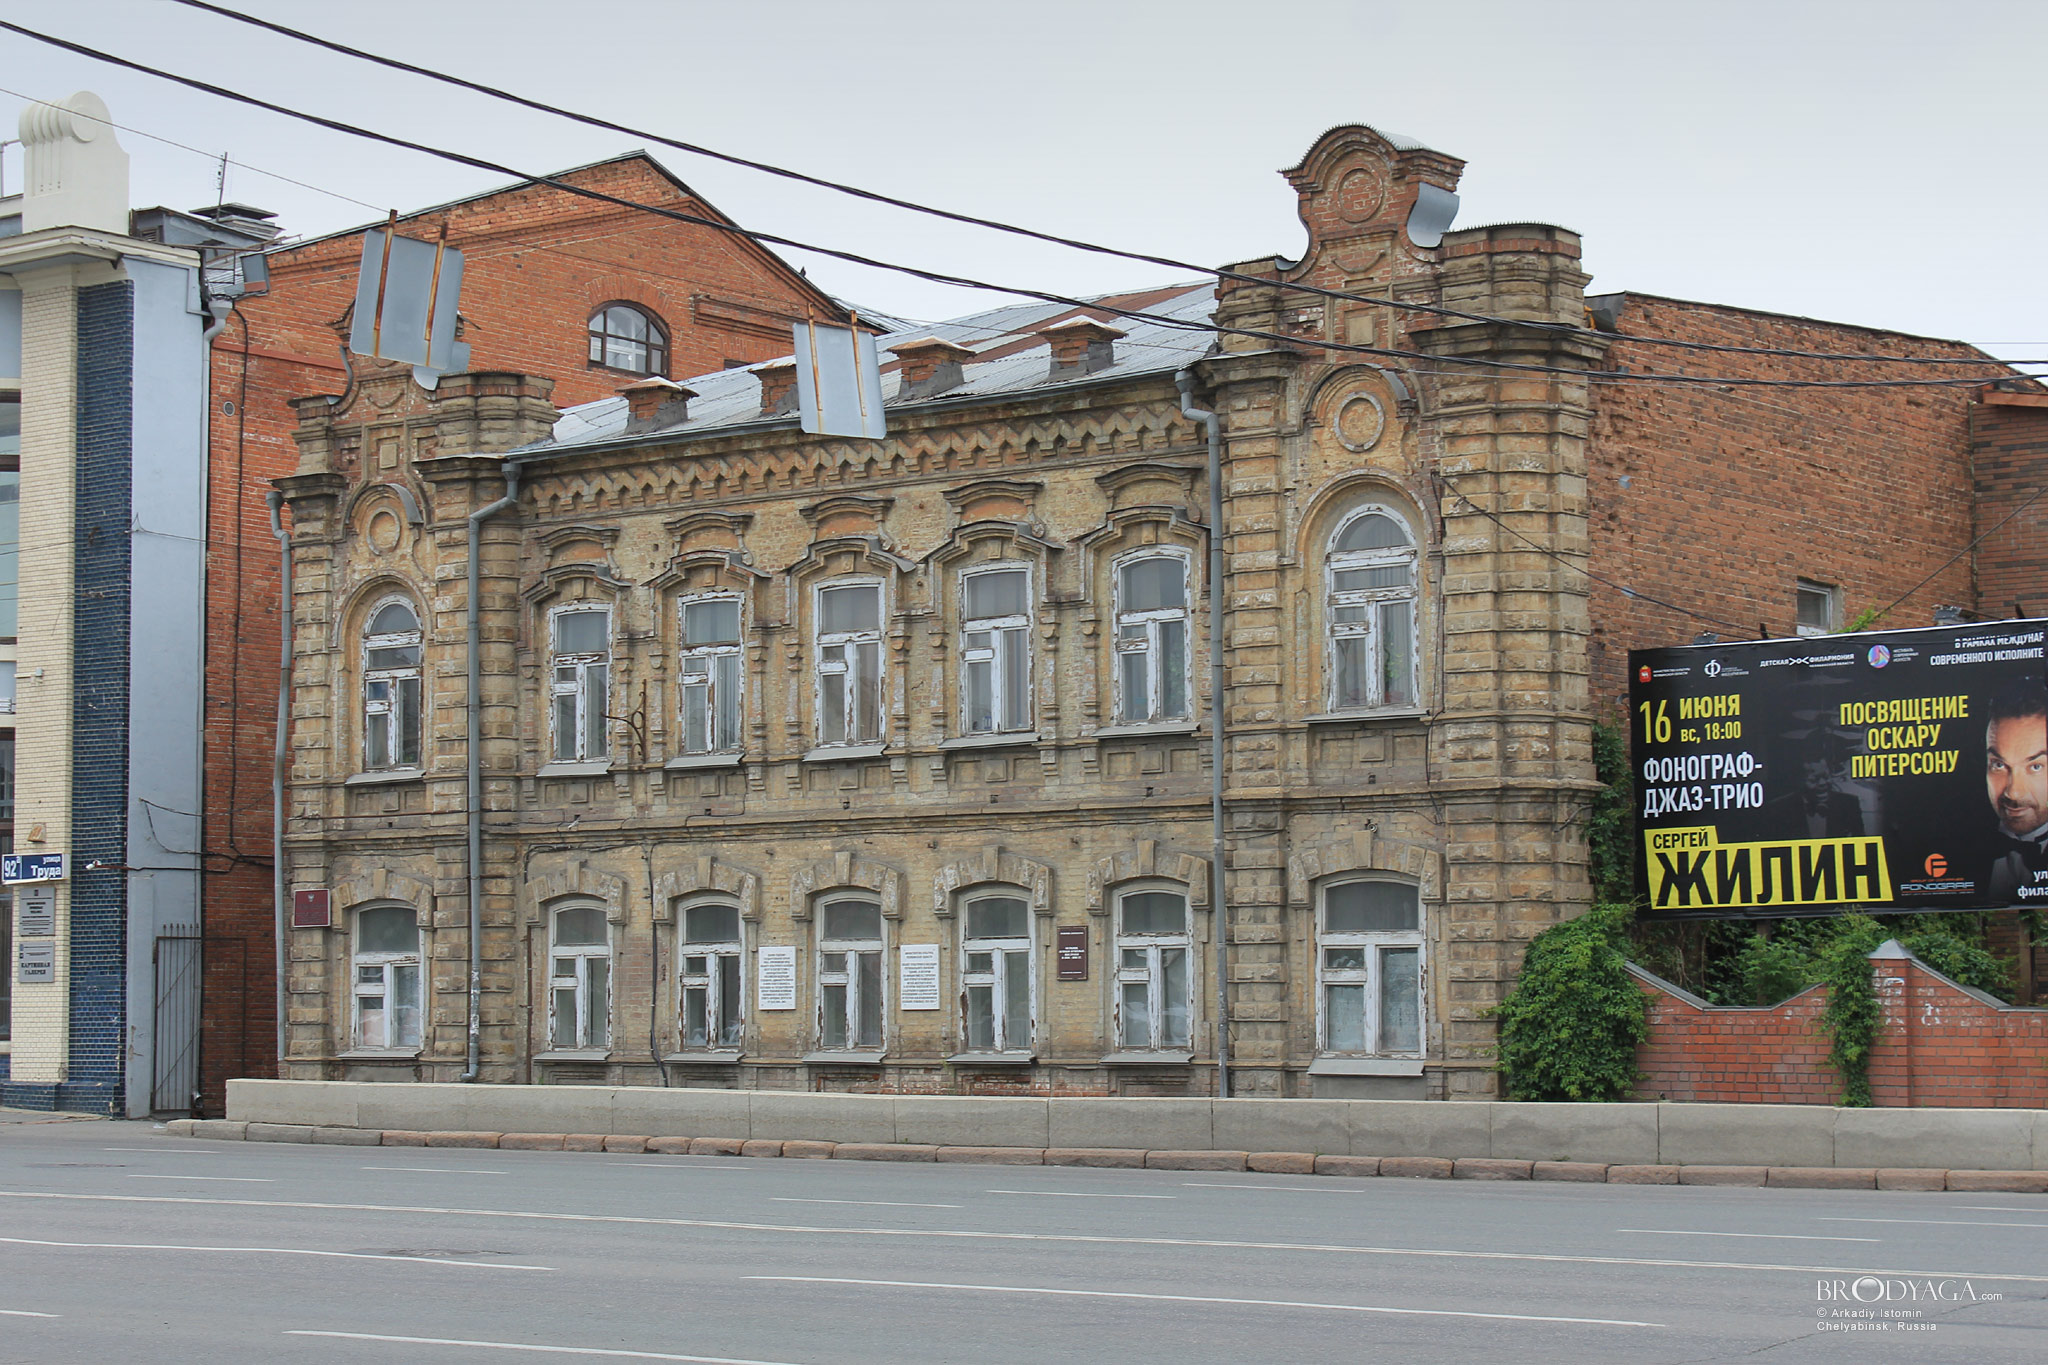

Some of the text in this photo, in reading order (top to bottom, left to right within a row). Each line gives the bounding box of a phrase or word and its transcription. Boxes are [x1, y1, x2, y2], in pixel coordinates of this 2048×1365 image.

[1760, 653, 1855, 667] ДЕТСКАЯ ФИЛАРМОНИЯ
[1930, 651, 1994, 666] СОВРЕМЕННОГО
[1994, 647, 2045, 661] ИСПОЛНИТЕ
[1639, 694, 1741, 744] 16 ИЮНЯ
[1839, 695, 1969, 726] ПОСВЯЩЕНИЕ
[1704, 721, 1742, 740] 18:00
[1867, 724, 1942, 751] ОСКАРУ
[1643, 751, 1763, 783] ФОНОГРАФ-
[1851, 750, 1960, 778] ПИТЕРСОНУ
[1643, 782, 1764, 818] ДЖАЗ-ТРИО
[1652, 828, 1709, 850] СЕРГЕЙ
[30, 864, 62, 879] Труда
[42, 855, 61, 865] улица
[1655, 842, 1881, 907] ЖИЛИН
[1900, 881, 1975, 891] FONOGRAF
